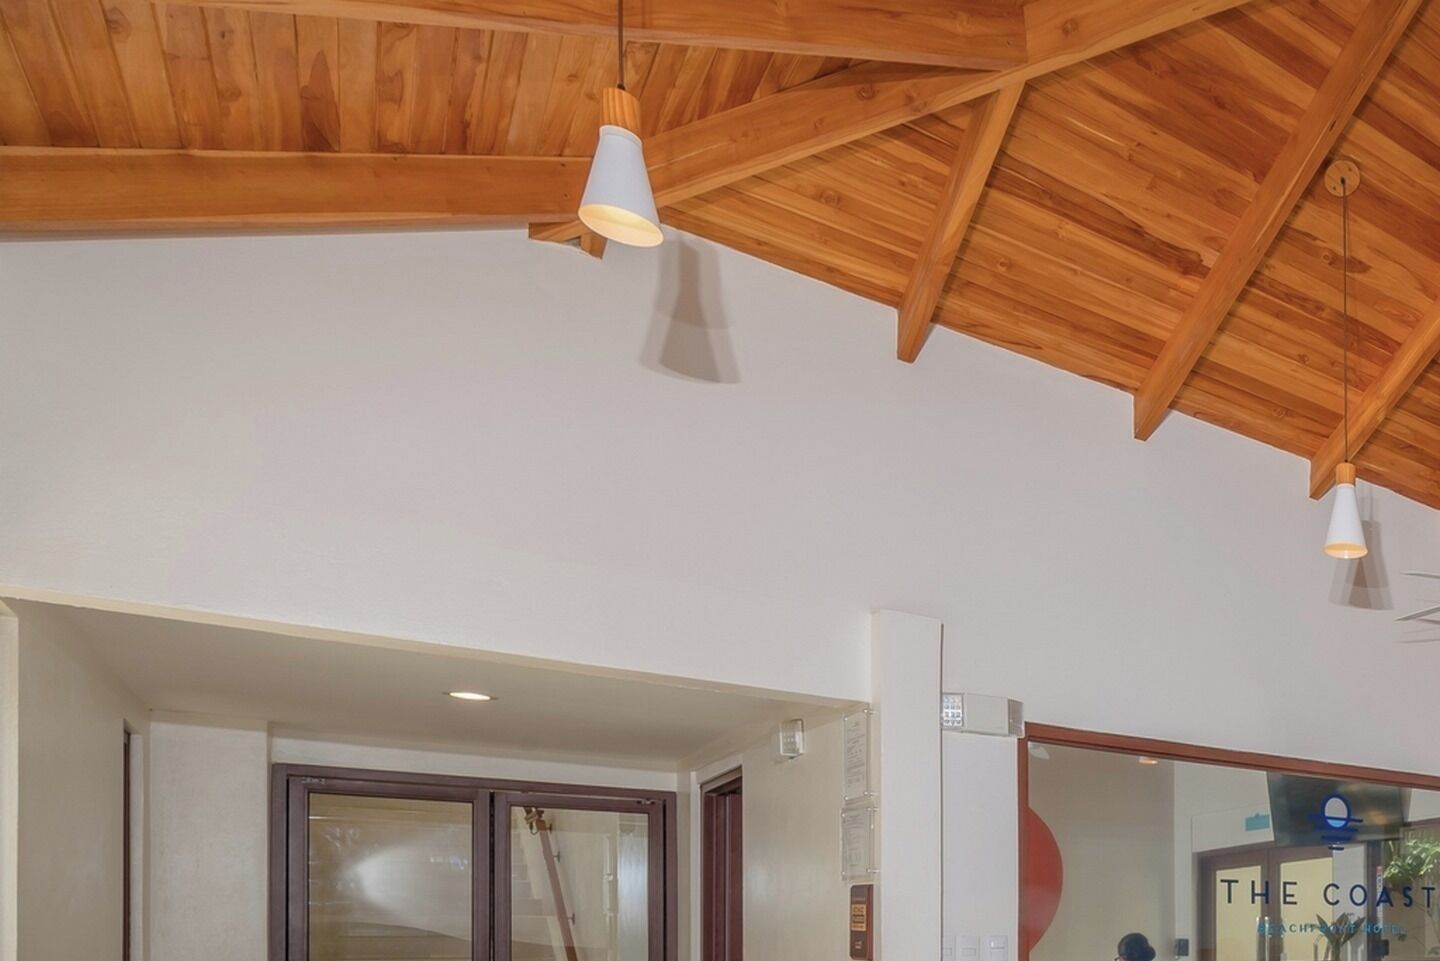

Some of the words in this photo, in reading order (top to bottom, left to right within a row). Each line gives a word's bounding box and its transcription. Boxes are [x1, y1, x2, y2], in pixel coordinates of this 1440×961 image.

[1220, 879, 1298, 905] THE
[1323, 883, 1436, 908] COAST
[1257, 921, 1357, 935] BEACHFRONT
[1362, 922, 1407, 934] HOTEL
